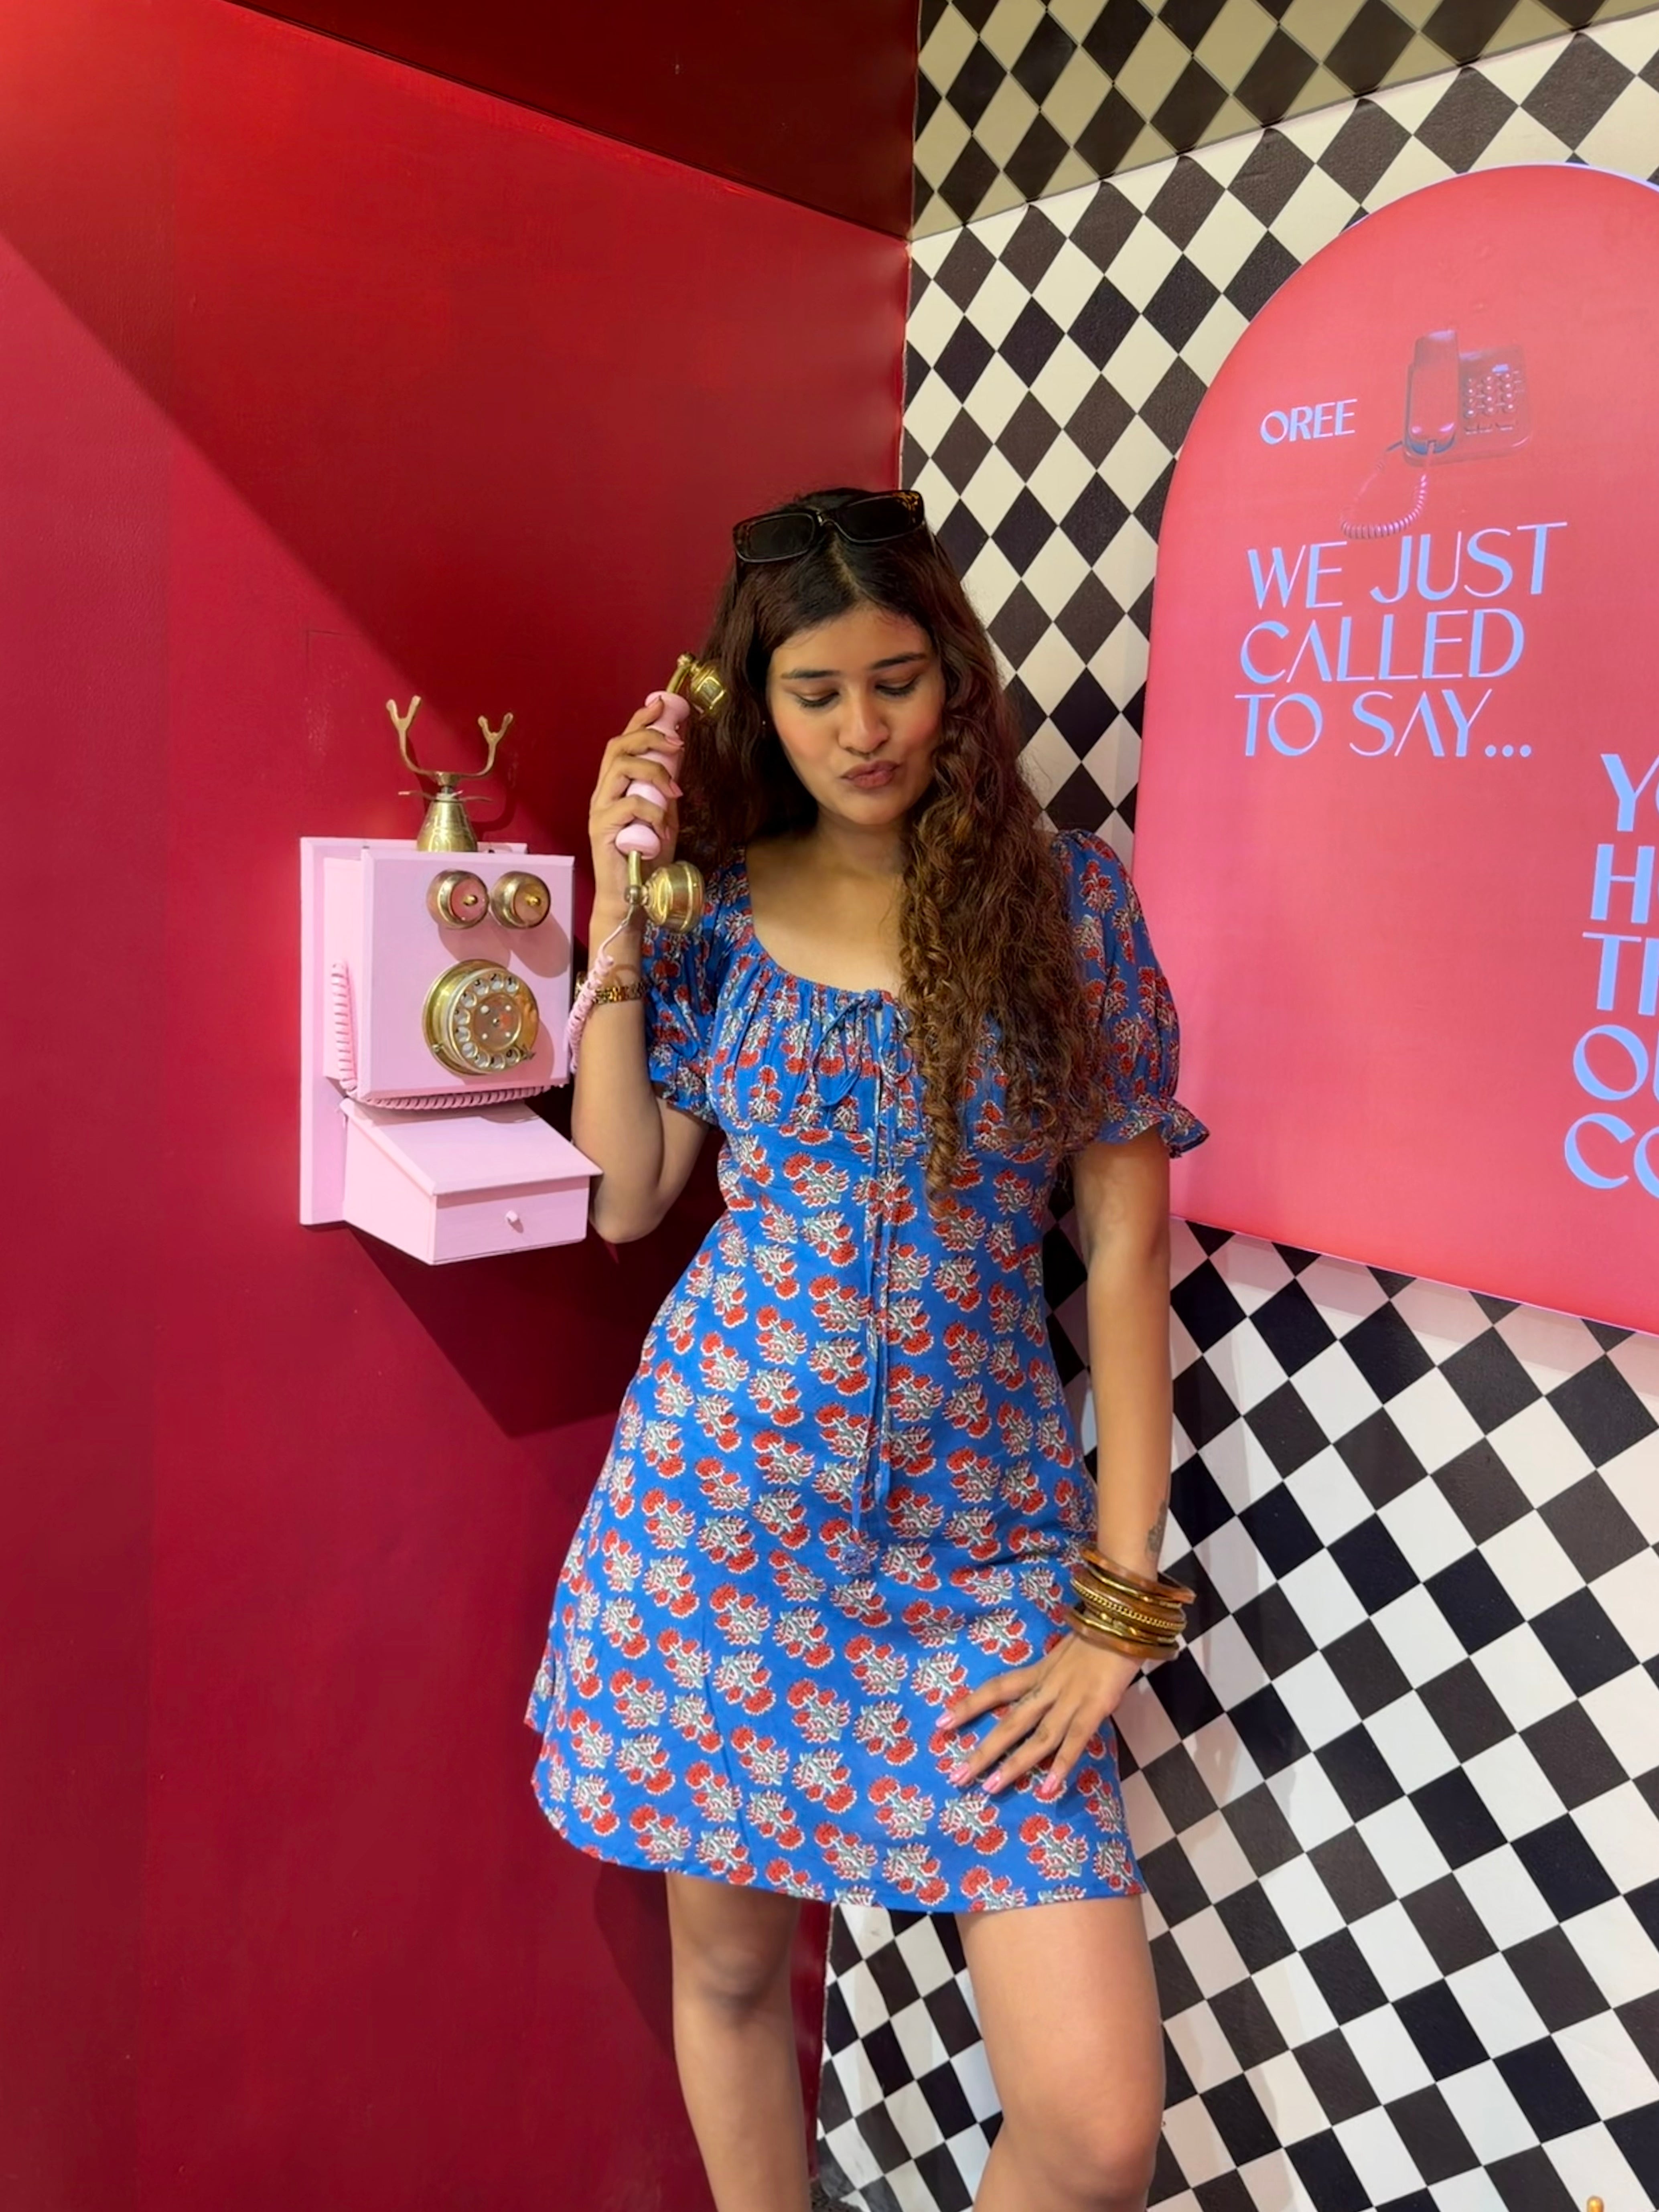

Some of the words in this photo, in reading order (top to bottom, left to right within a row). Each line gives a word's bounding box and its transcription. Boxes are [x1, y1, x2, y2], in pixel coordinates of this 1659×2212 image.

[1260, 399, 1357, 445] OREE
[1247, 541, 1347, 610] WE
[1370, 521, 1568, 604] JUST
[1239, 608, 1525, 684] CALLED
[1234, 693, 1324, 757] TO
[1349, 688, 1532, 758] SAY...
[1600, 753, 1659, 832] Y
[1590, 843, 1659, 924] H
[1572, 1024, 1659, 1102] O
